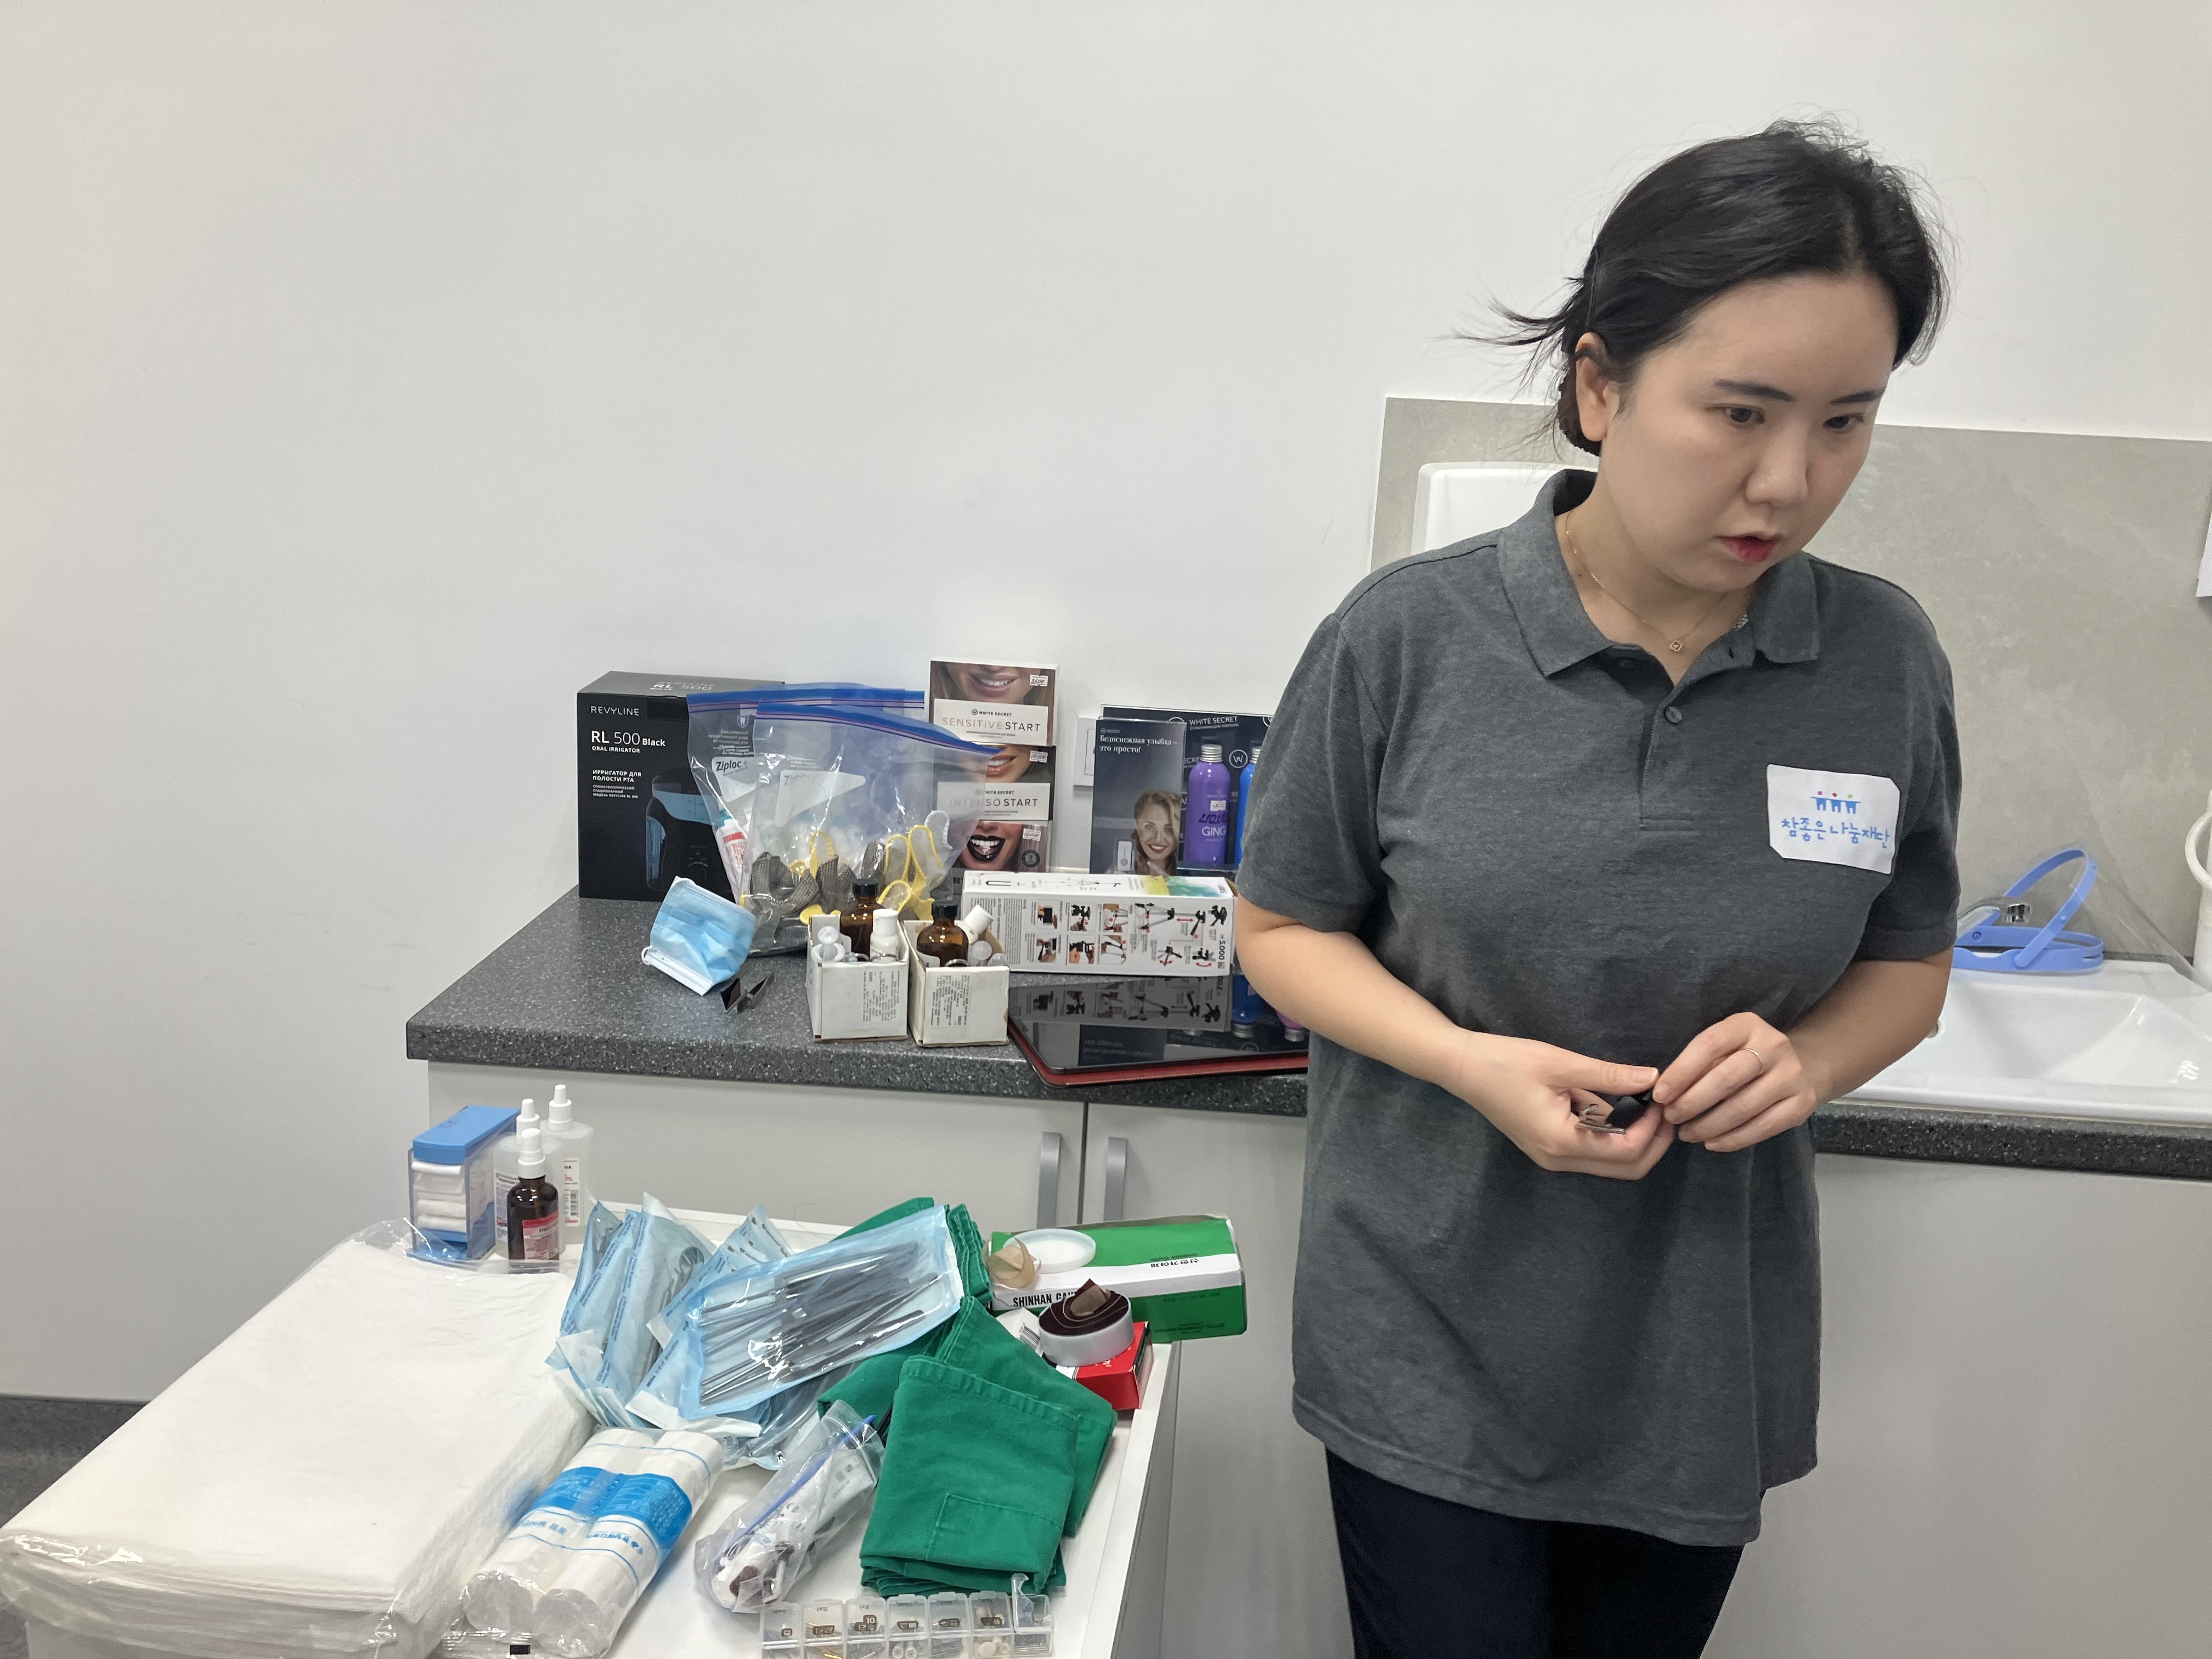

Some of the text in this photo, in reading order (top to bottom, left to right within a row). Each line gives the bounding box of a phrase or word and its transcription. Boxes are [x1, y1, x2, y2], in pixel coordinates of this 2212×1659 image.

[591, 706, 640, 716] REVYLINE
[942, 716, 1041, 732] SENSITIVE START
[1189, 715, 1238, 726] WHITE SECRET
[591, 730, 665, 747] RL 500 Black
[1100, 734, 1146, 744] Белоснежная
[1147, 737, 1172, 746] улыбка
[1113, 746, 1141, 754] просто!
[1183, 756, 1200, 764] ECRE
[715, 760, 742, 772] Ziploc
[1003, 798, 1038, 806] START
[1013, 1294, 1052, 1307] SHINHAN
